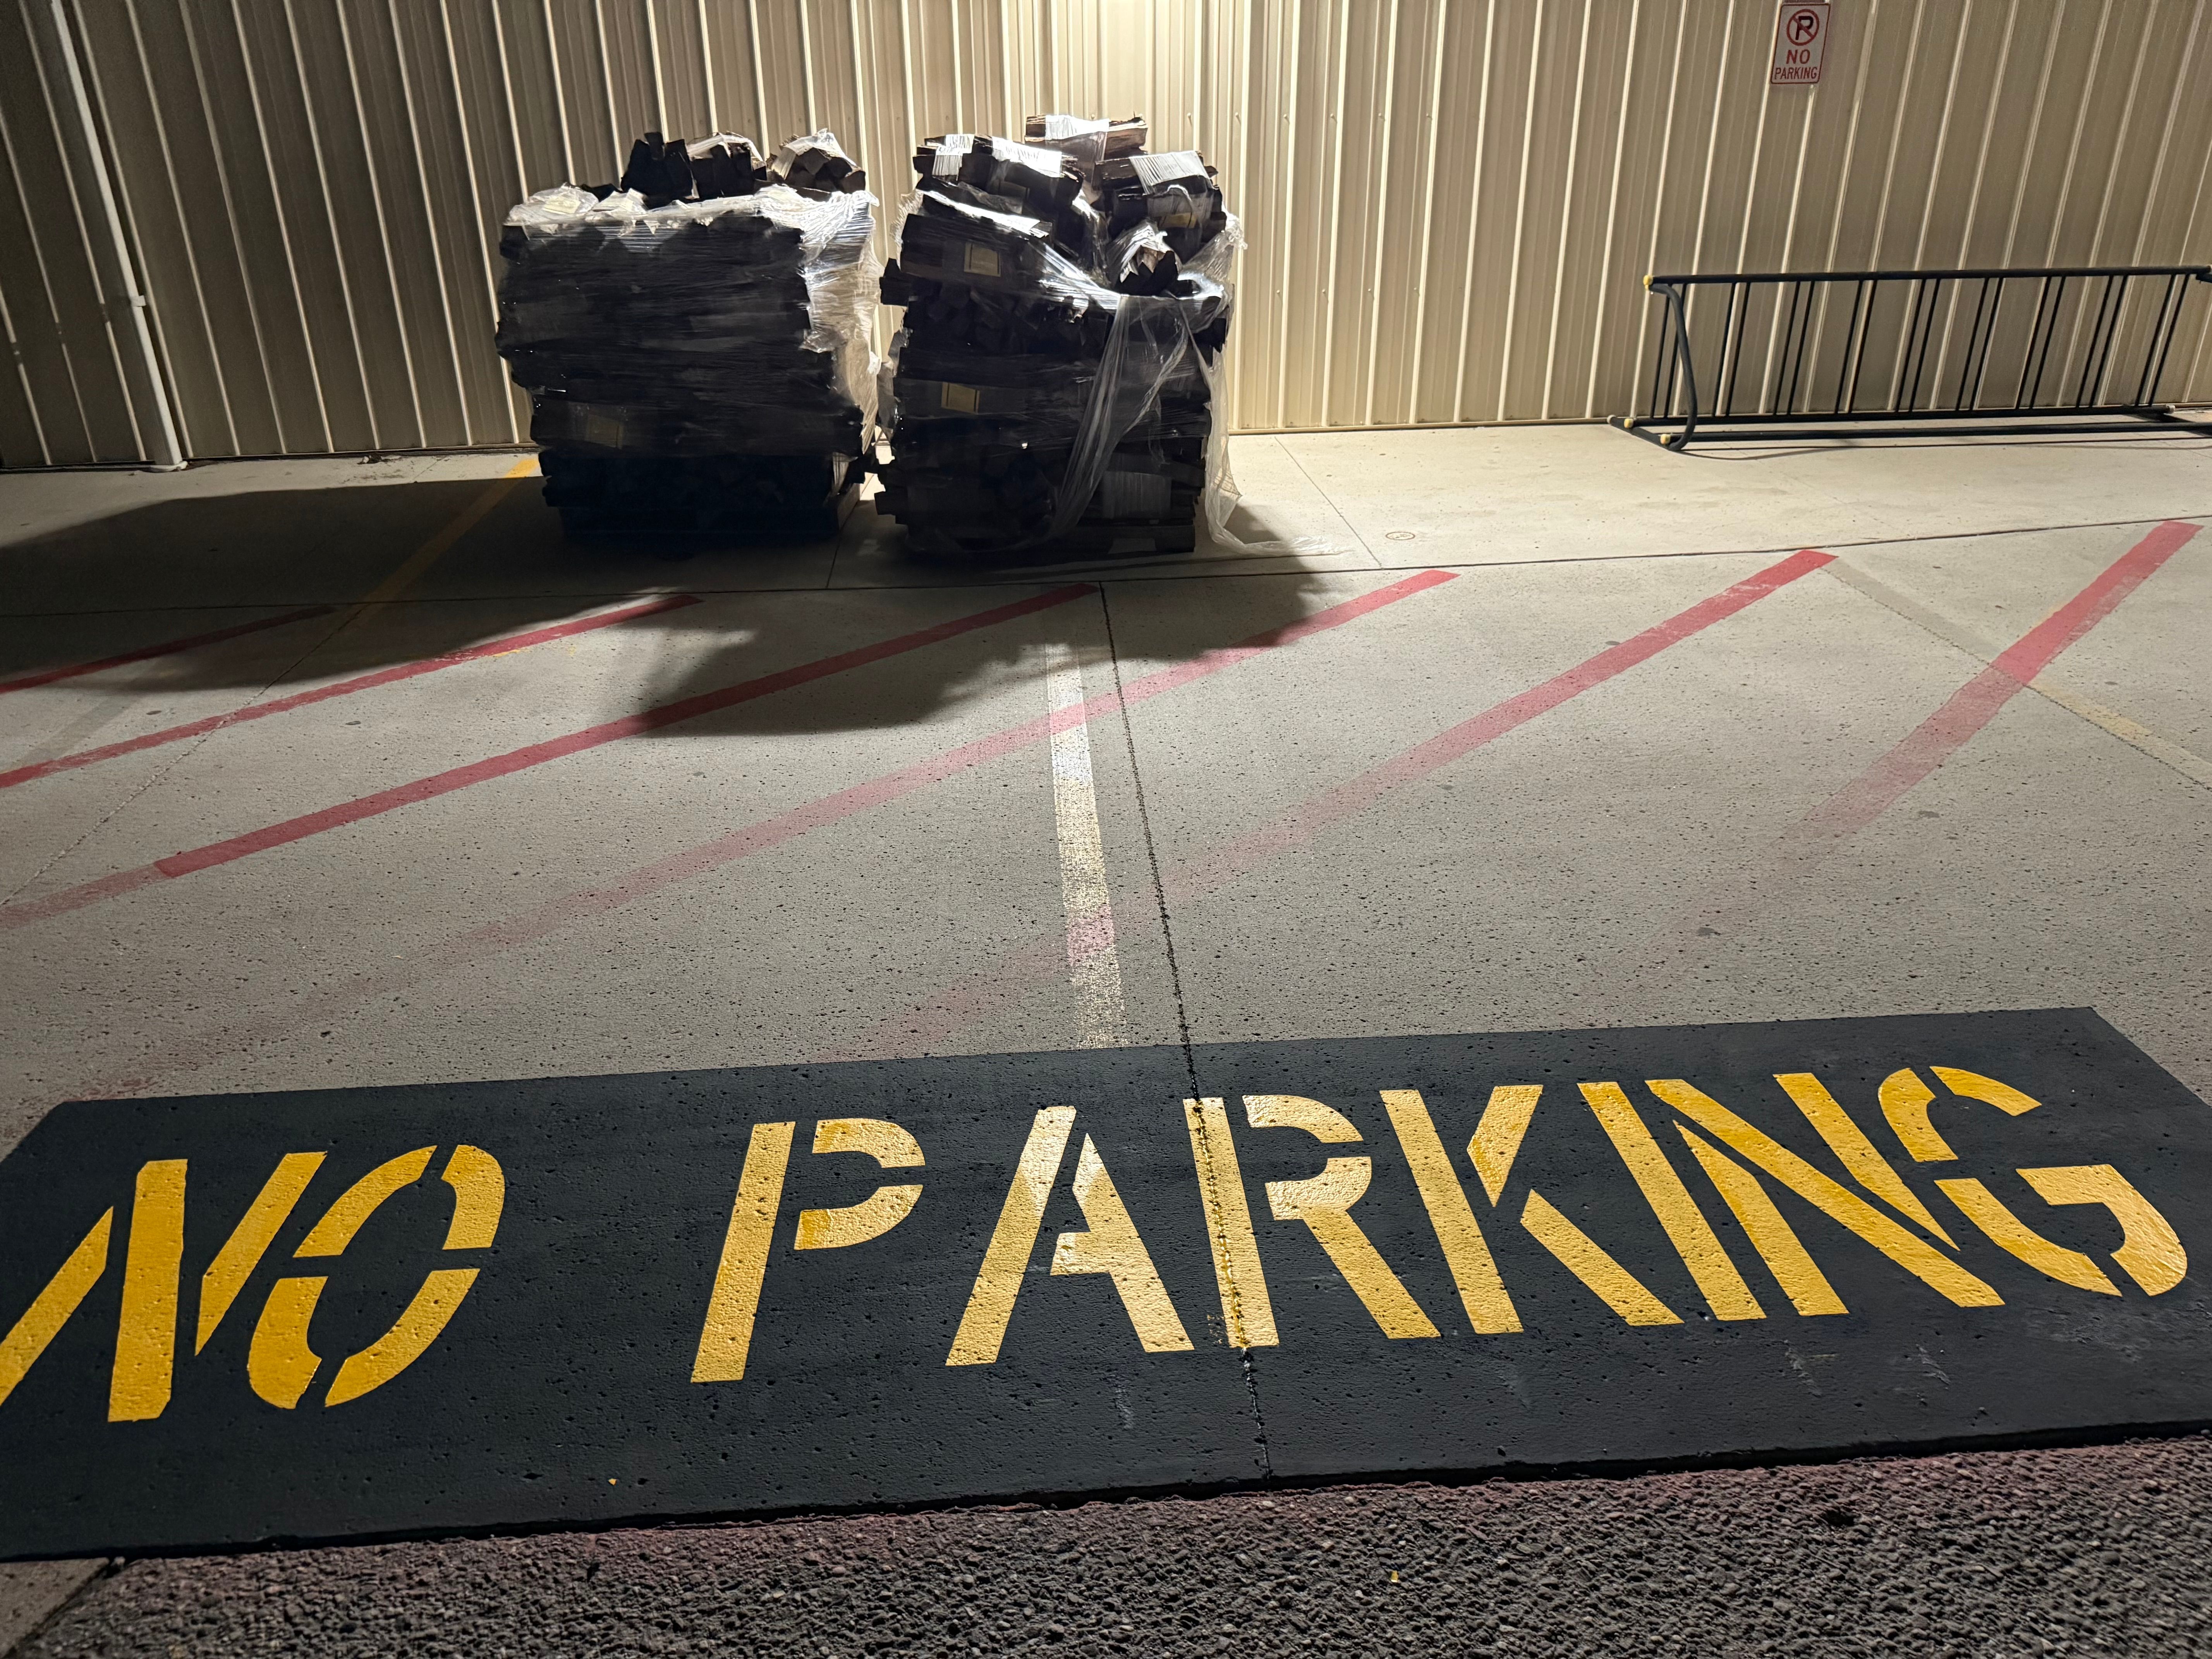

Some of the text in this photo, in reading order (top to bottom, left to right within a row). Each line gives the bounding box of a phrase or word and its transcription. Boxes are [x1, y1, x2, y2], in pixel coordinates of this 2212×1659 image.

[1786, 49, 1810, 64] NO
[1775, 67, 1817, 79] PARKING
[0, 1065, 2188, 1422] NO PARKING
